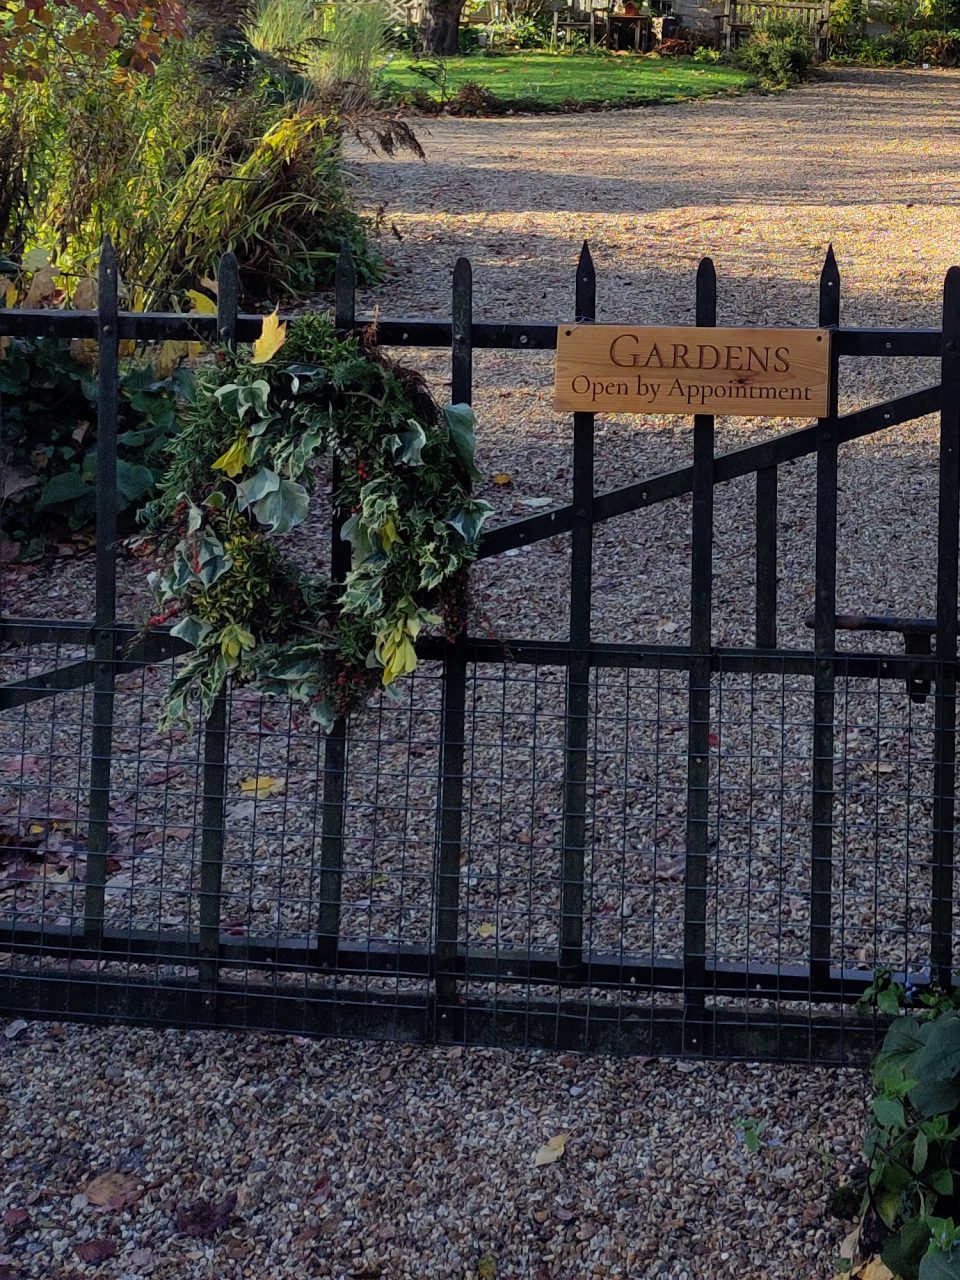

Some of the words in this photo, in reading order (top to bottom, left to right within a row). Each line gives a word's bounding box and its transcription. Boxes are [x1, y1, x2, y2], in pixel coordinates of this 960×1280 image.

[571, 375, 629, 401] Open
[637, 375, 661, 403] by
[667, 377, 812, 405] Appointment
